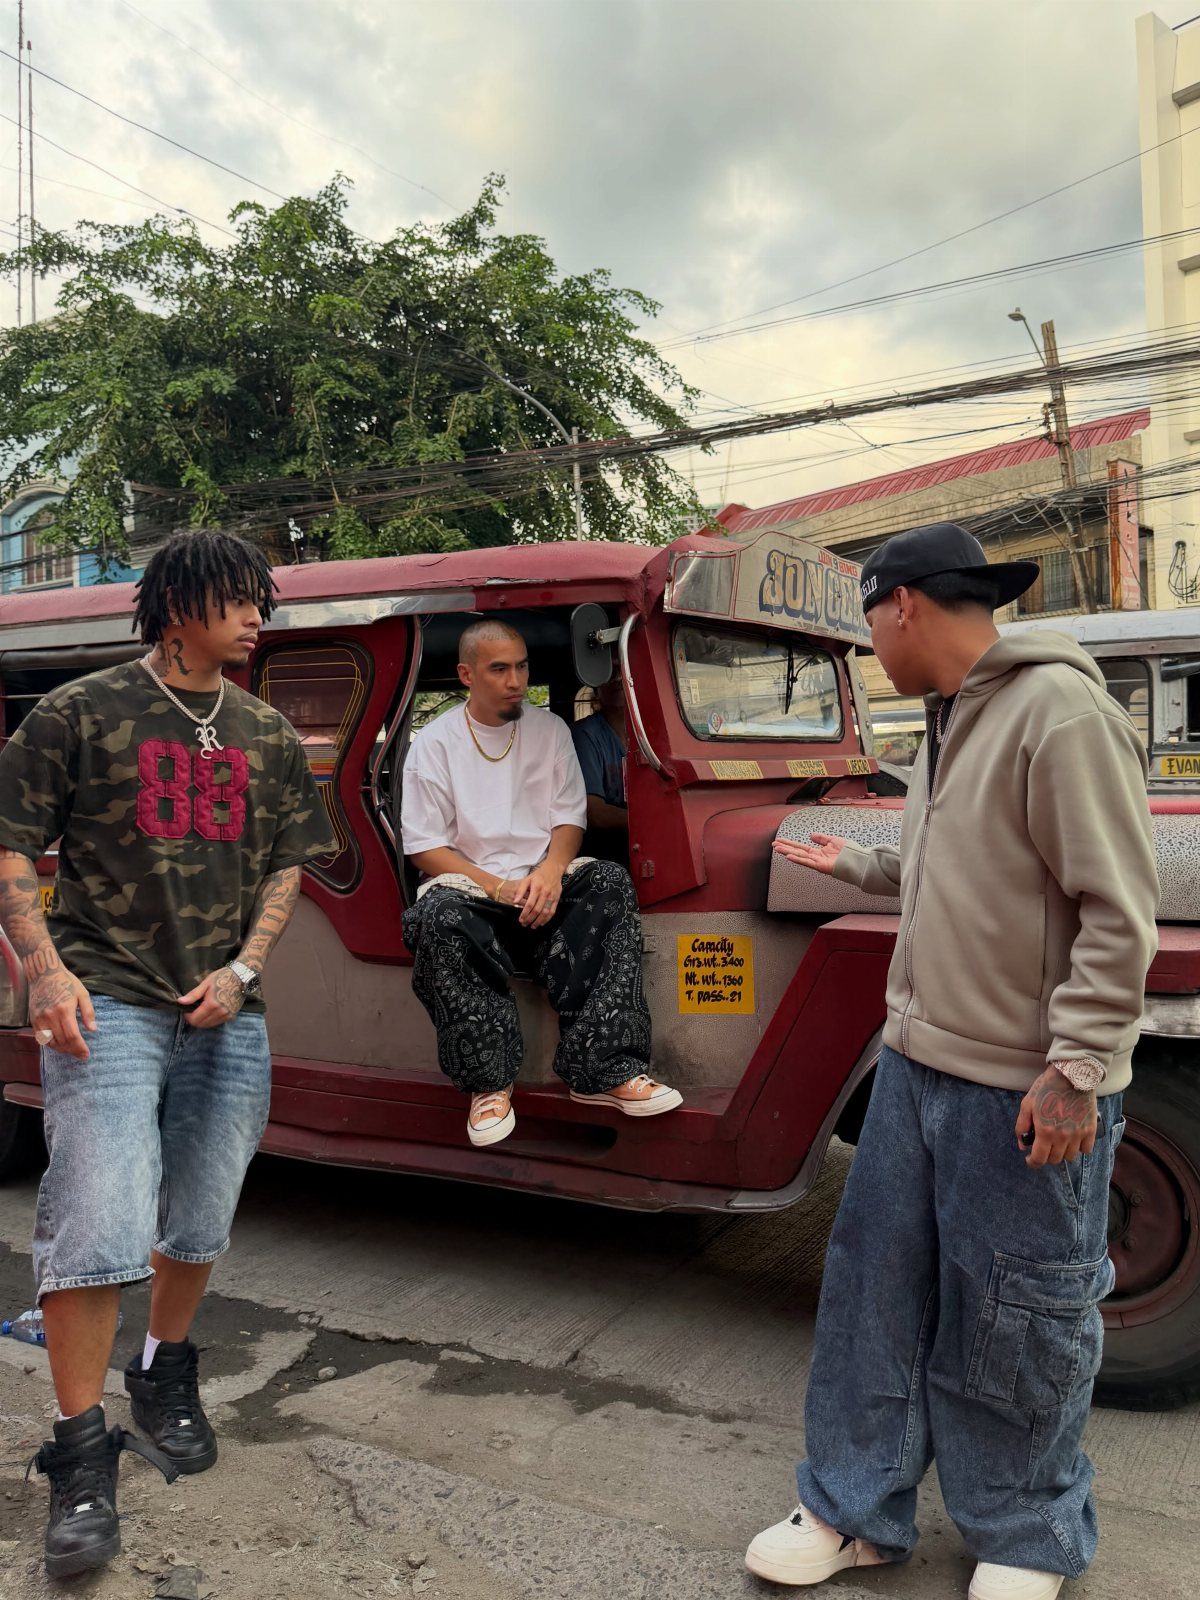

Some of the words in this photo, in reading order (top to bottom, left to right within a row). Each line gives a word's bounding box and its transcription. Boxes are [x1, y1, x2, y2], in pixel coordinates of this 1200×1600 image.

[760, 549, 824, 623] JON
[136, 738, 250, 842] 88
[692, 937, 734, 957] Capacity
[729, 990, 742, 1003] 21
